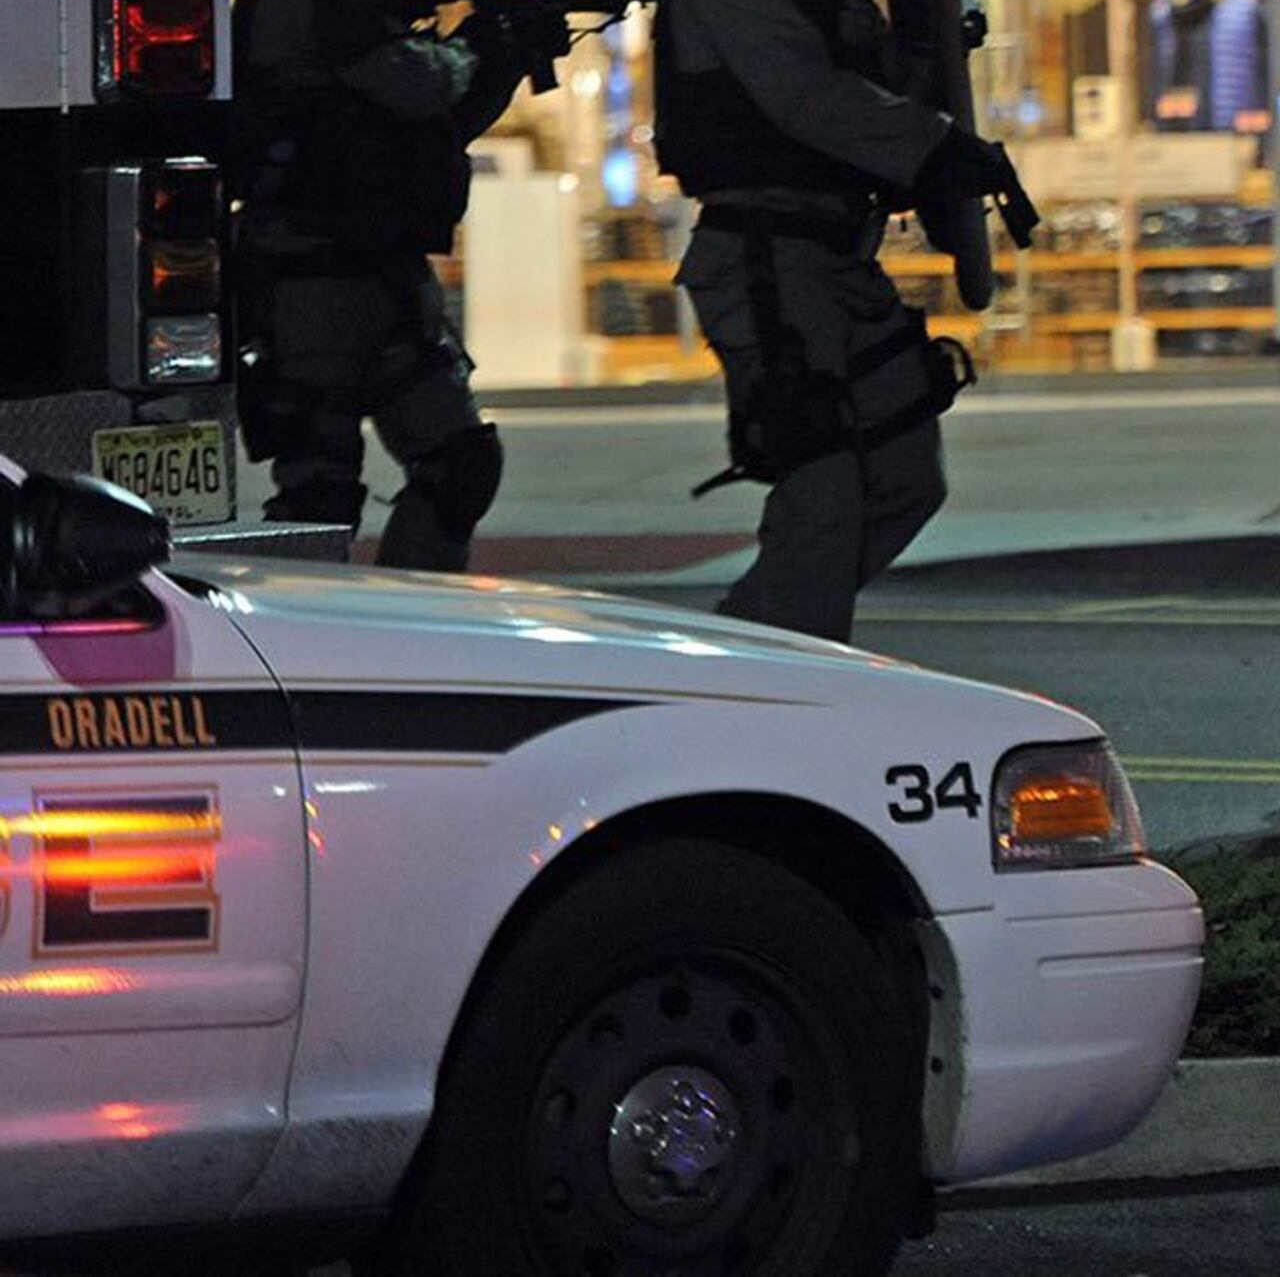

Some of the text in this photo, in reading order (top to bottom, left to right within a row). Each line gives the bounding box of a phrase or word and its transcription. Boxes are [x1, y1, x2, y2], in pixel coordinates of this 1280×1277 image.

[49, 695, 216, 749] ORADELL
[885, 761, 983, 824] 34
[0, 783, 222, 962] E
